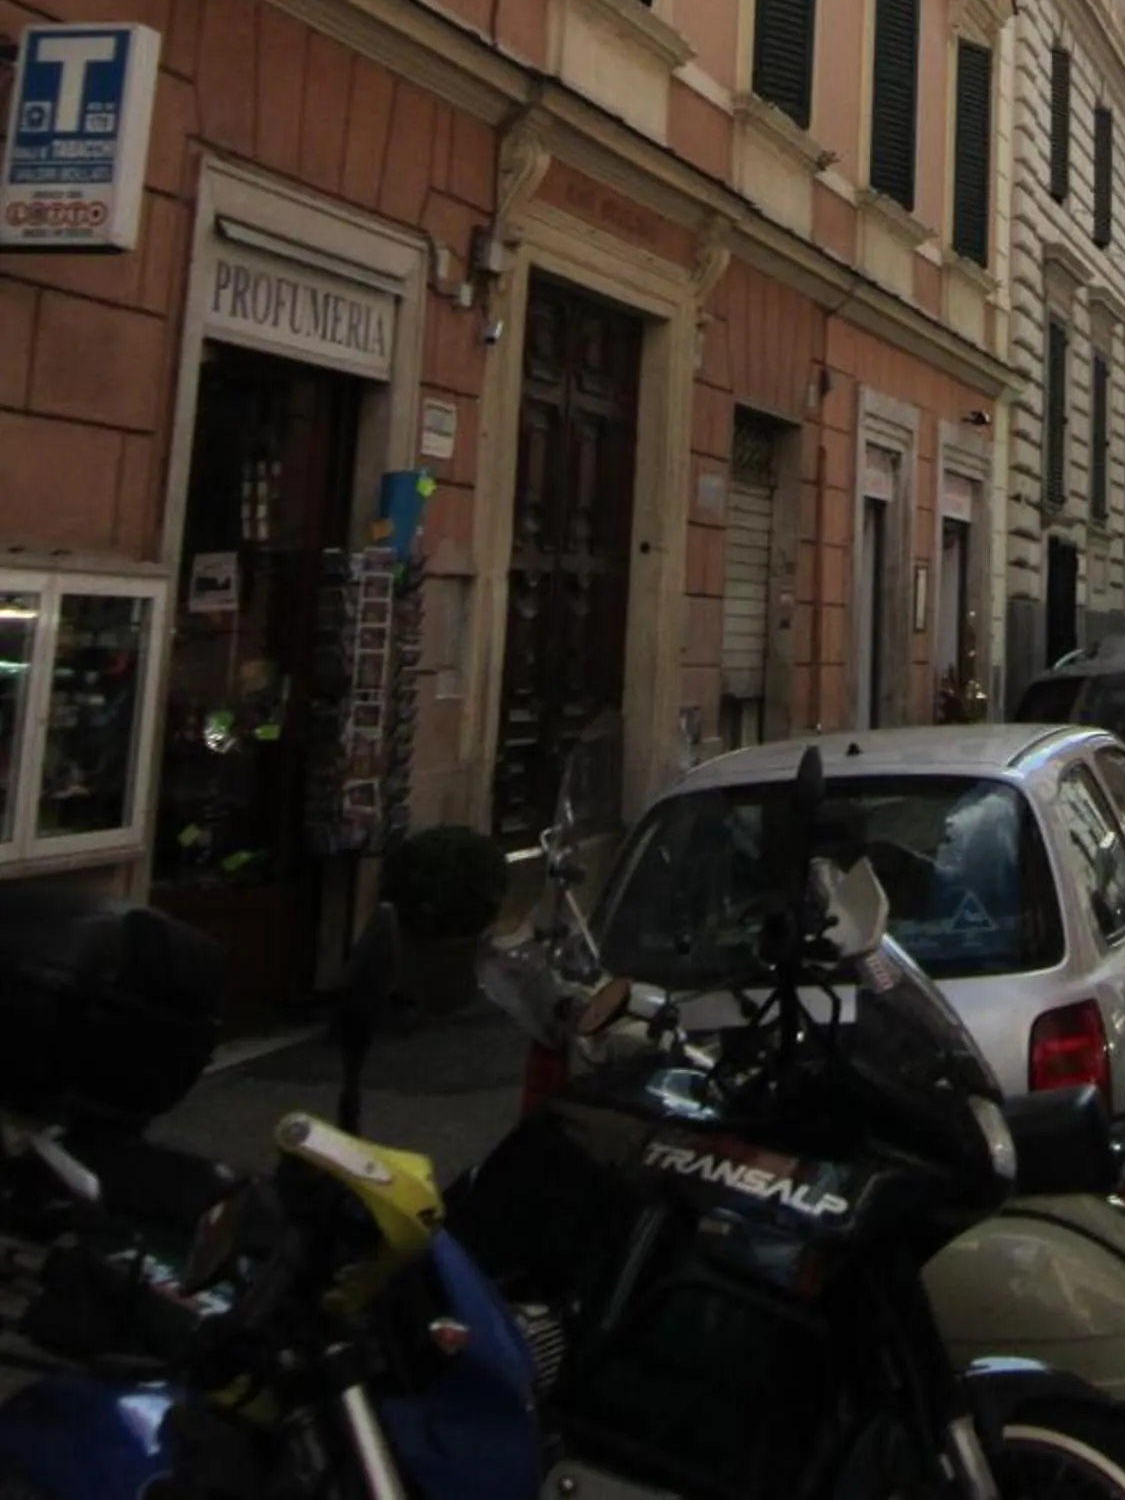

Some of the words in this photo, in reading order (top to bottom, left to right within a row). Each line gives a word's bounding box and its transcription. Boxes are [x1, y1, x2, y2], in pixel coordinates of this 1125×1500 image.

[36, 36, 116, 132] T
[212, 259, 386, 357] PROFUMERIA
[642, 1141, 850, 1217] TRANSALP
